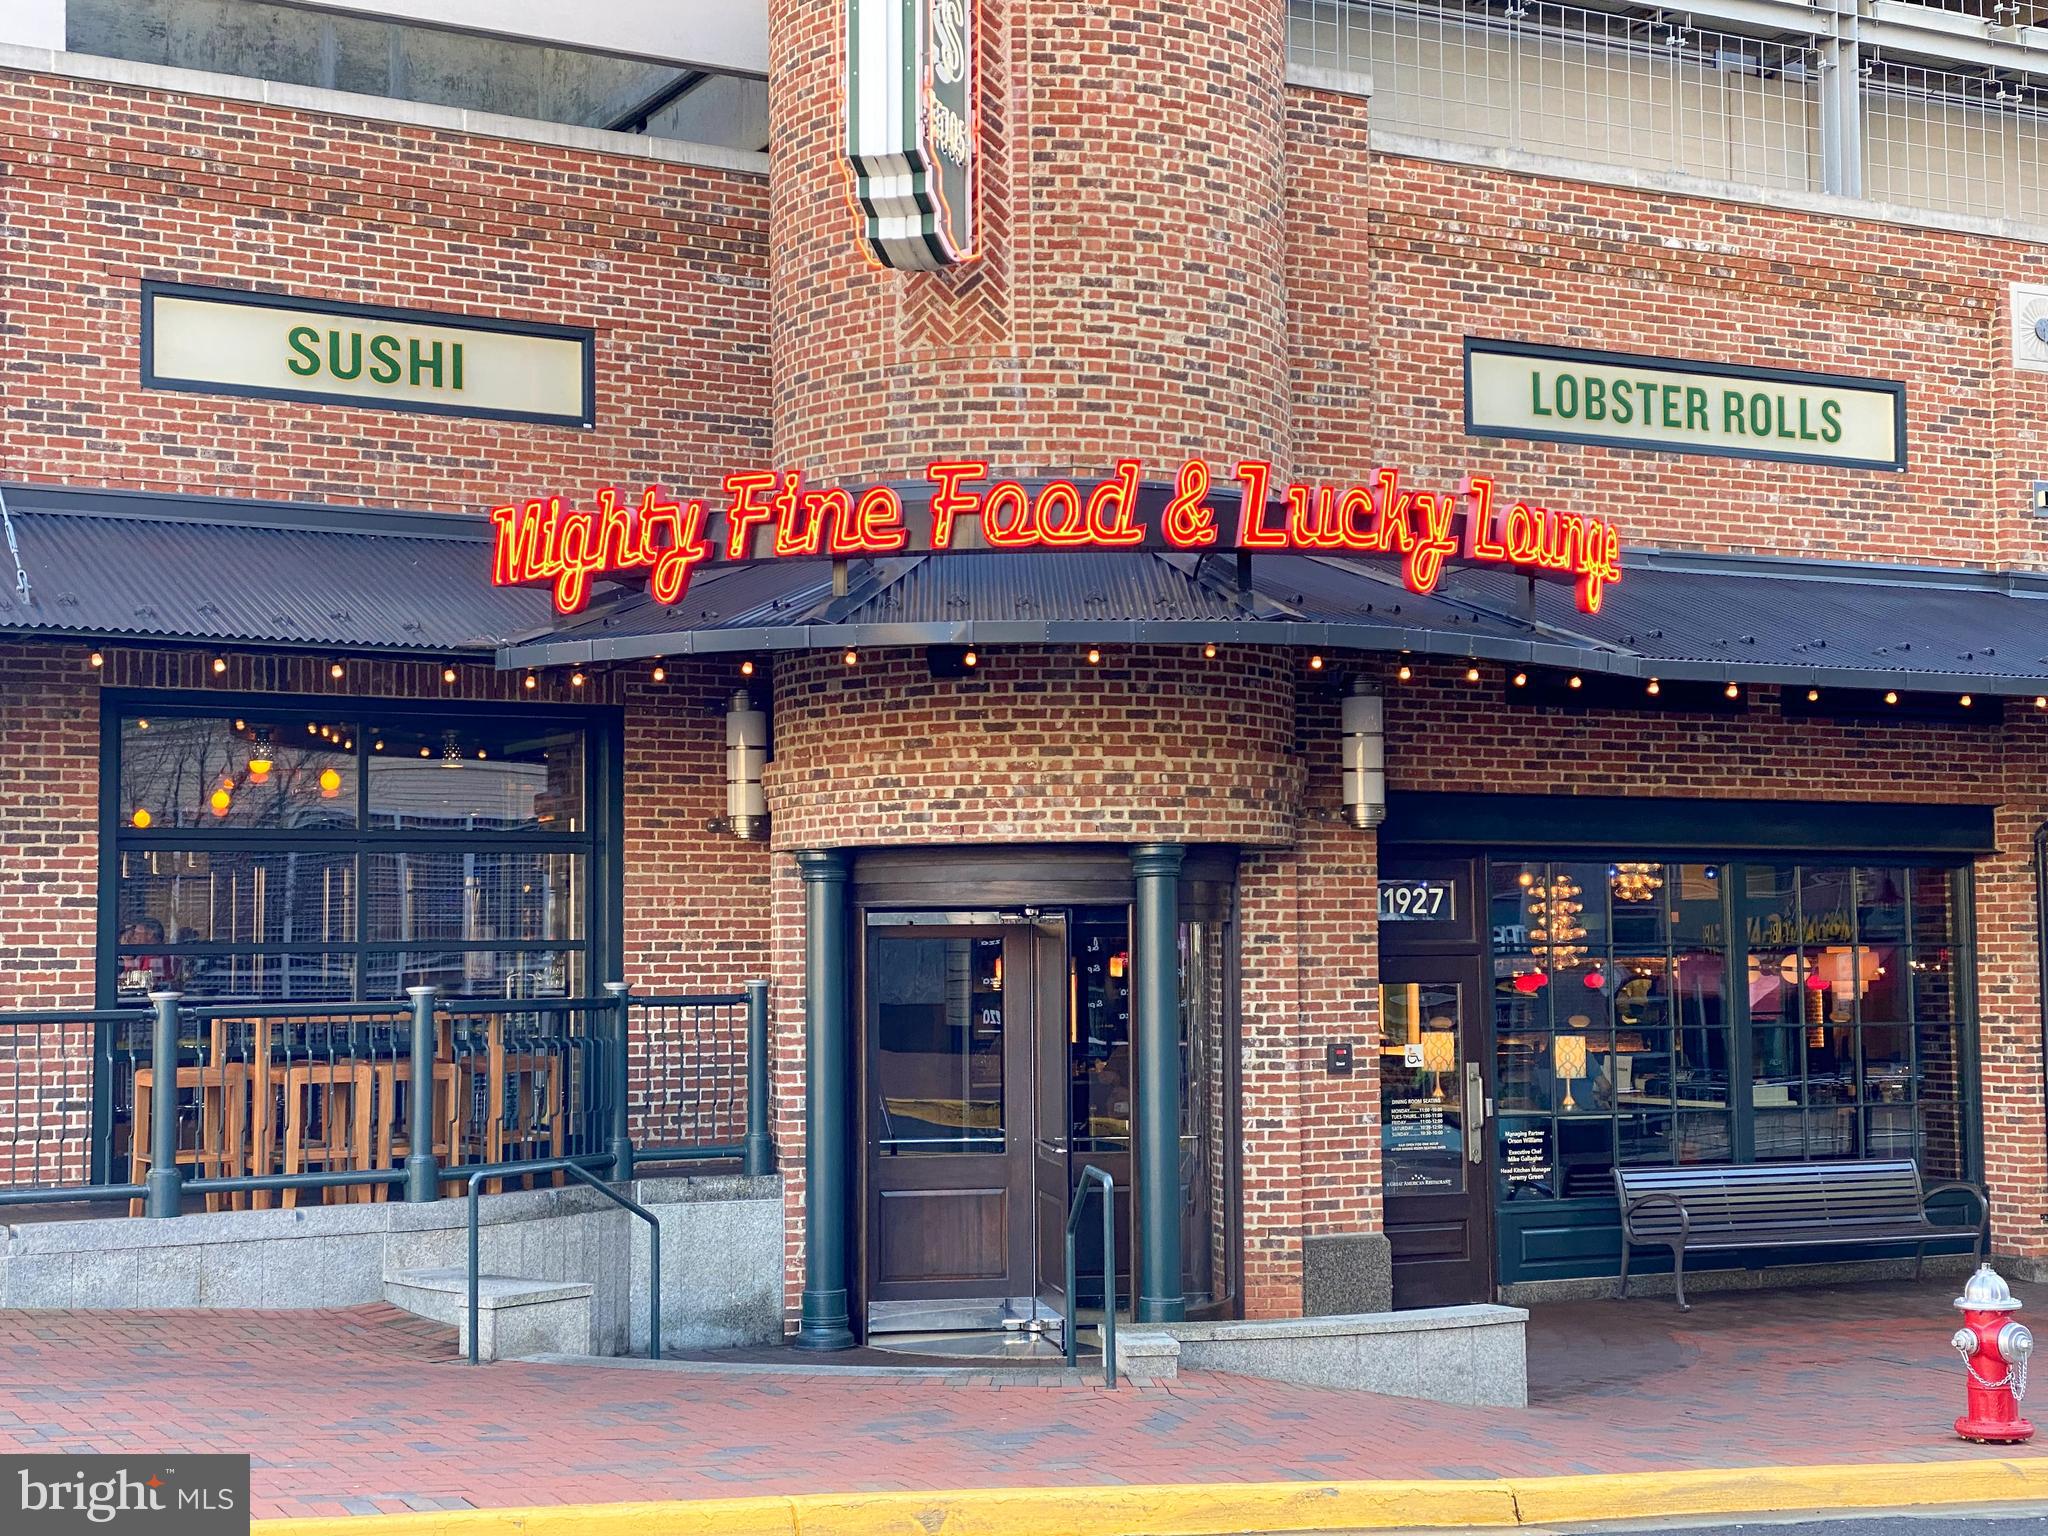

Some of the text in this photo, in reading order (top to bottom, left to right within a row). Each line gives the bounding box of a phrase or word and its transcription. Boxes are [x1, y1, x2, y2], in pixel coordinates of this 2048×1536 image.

[287, 326, 464, 391] SUSHI
[1531, 370, 1843, 443] LOBSTER ROLLS
[489, 458, 1622, 615] Mighty Fine Food & Lucky Lounge
